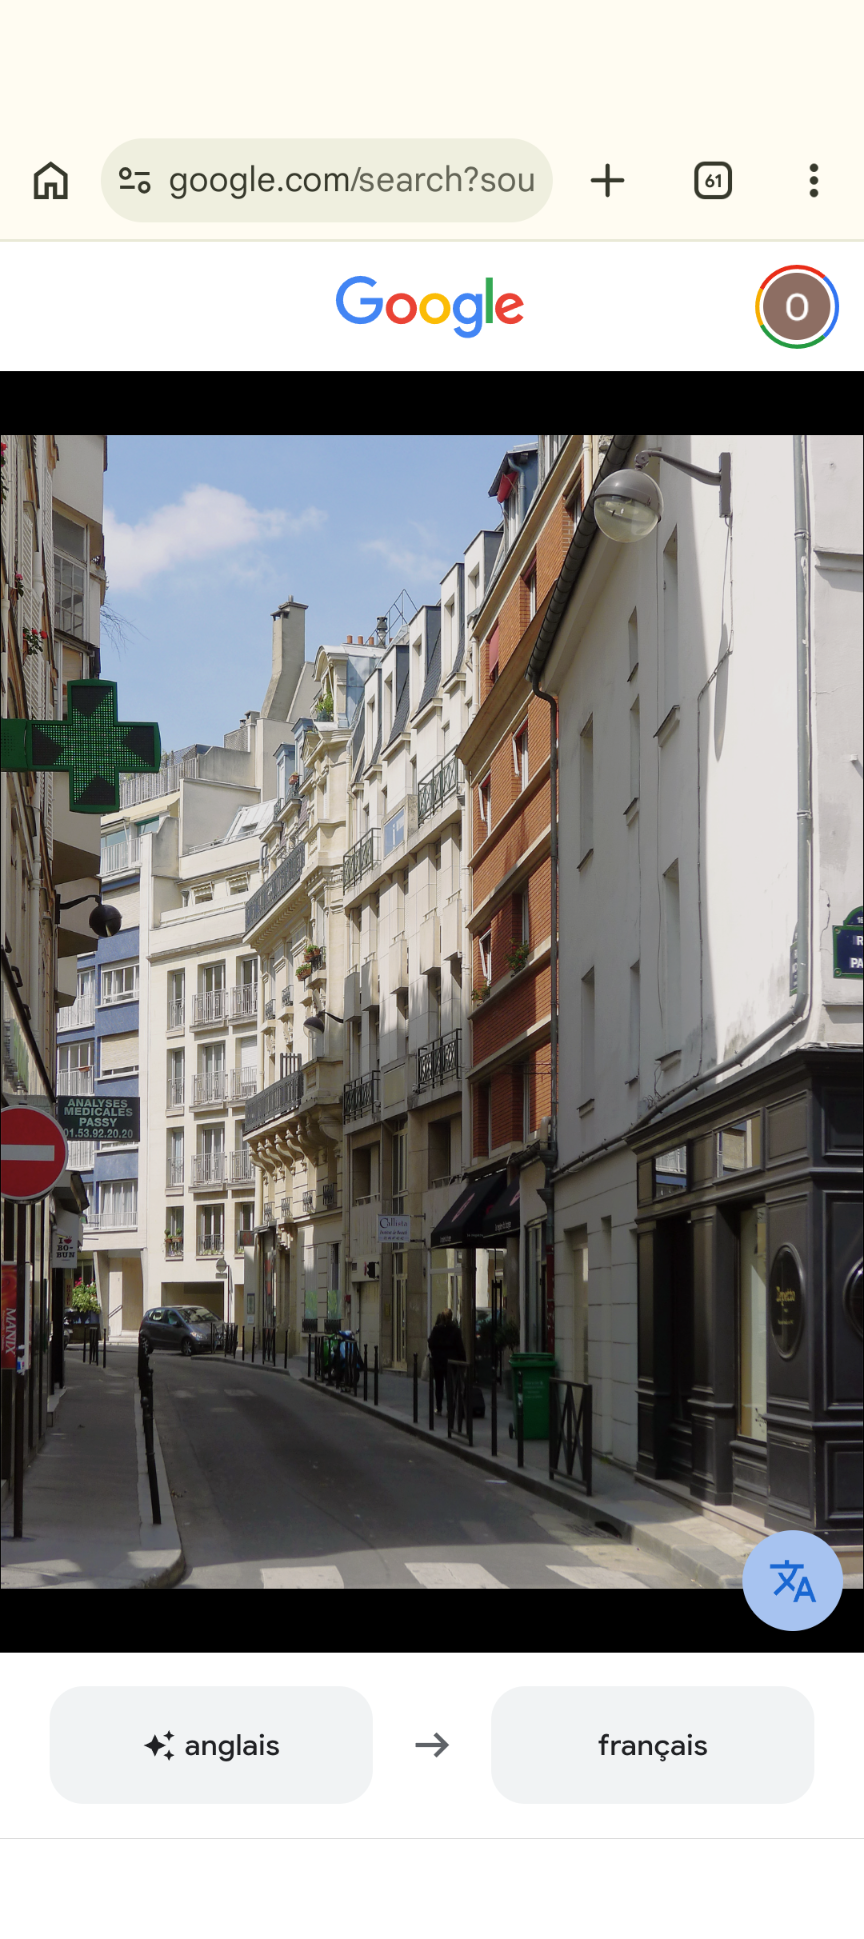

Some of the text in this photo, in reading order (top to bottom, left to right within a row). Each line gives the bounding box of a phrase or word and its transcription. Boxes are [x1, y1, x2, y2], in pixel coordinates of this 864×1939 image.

[169, 164, 535, 200] google.com/search?sou
[705, 172, 723, 190] 61
[335, 275, 525, 339] Google
[67, 1098, 128, 1108] ANALYSES
[63, 1107, 133, 1117] MEDICALES
[79, 1117, 118, 1127] PASSY
[63, 1128, 134, 1139] 01.53.92.20.20
[379, 1217, 408, 1229] Callista
[57, 1244, 74, 1252] BO-
[6, 1307, 17, 1356] MANIX
[184, 1733, 280, 1763] anglais
[597, 1732, 709, 1763] français
